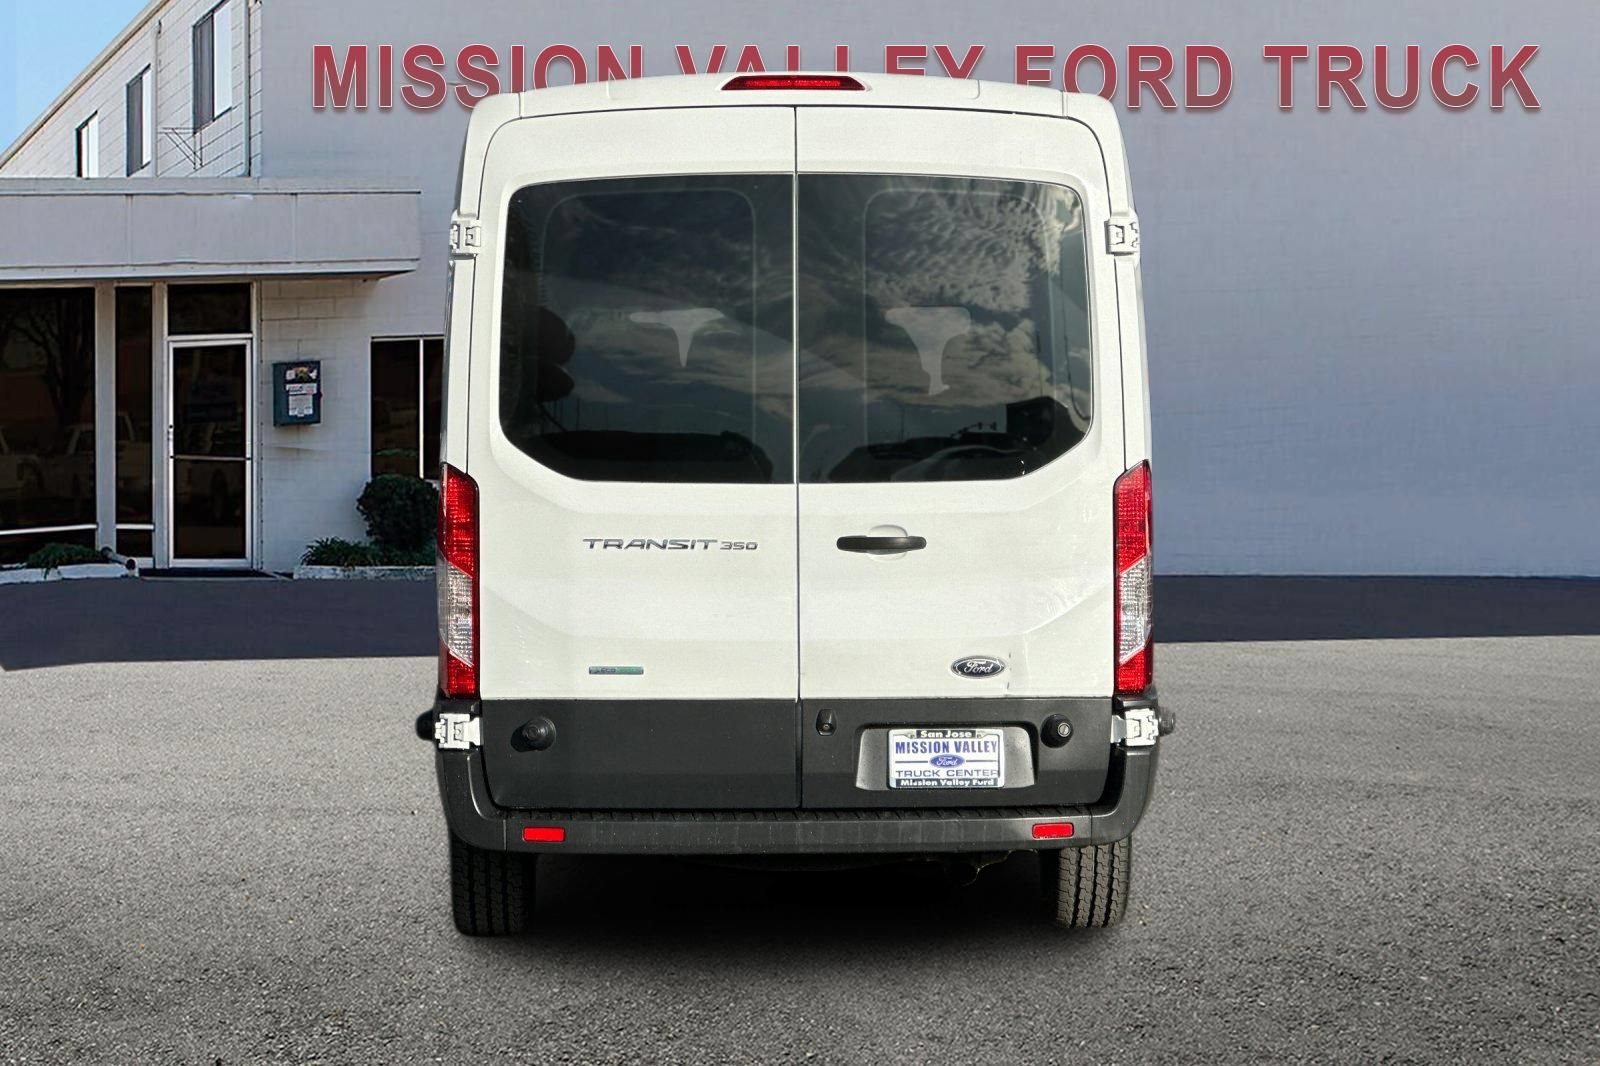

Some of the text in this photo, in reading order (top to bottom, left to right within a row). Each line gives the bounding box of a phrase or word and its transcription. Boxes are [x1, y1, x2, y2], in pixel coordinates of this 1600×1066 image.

[312, 43, 643, 109] MISSION
[1014, 43, 1233, 108] FORD
[1263, 44, 1541, 109] TRUCK
[583, 538, 758, 551] TRANSIT 350
[964, 661, 994, 673] Ford
[920, 730, 972, 739] San Jose
[895, 740, 998, 754] MISSION VALLEY
[946, 769, 998, 777] CENTER
[940, 779, 970, 787] Valley
